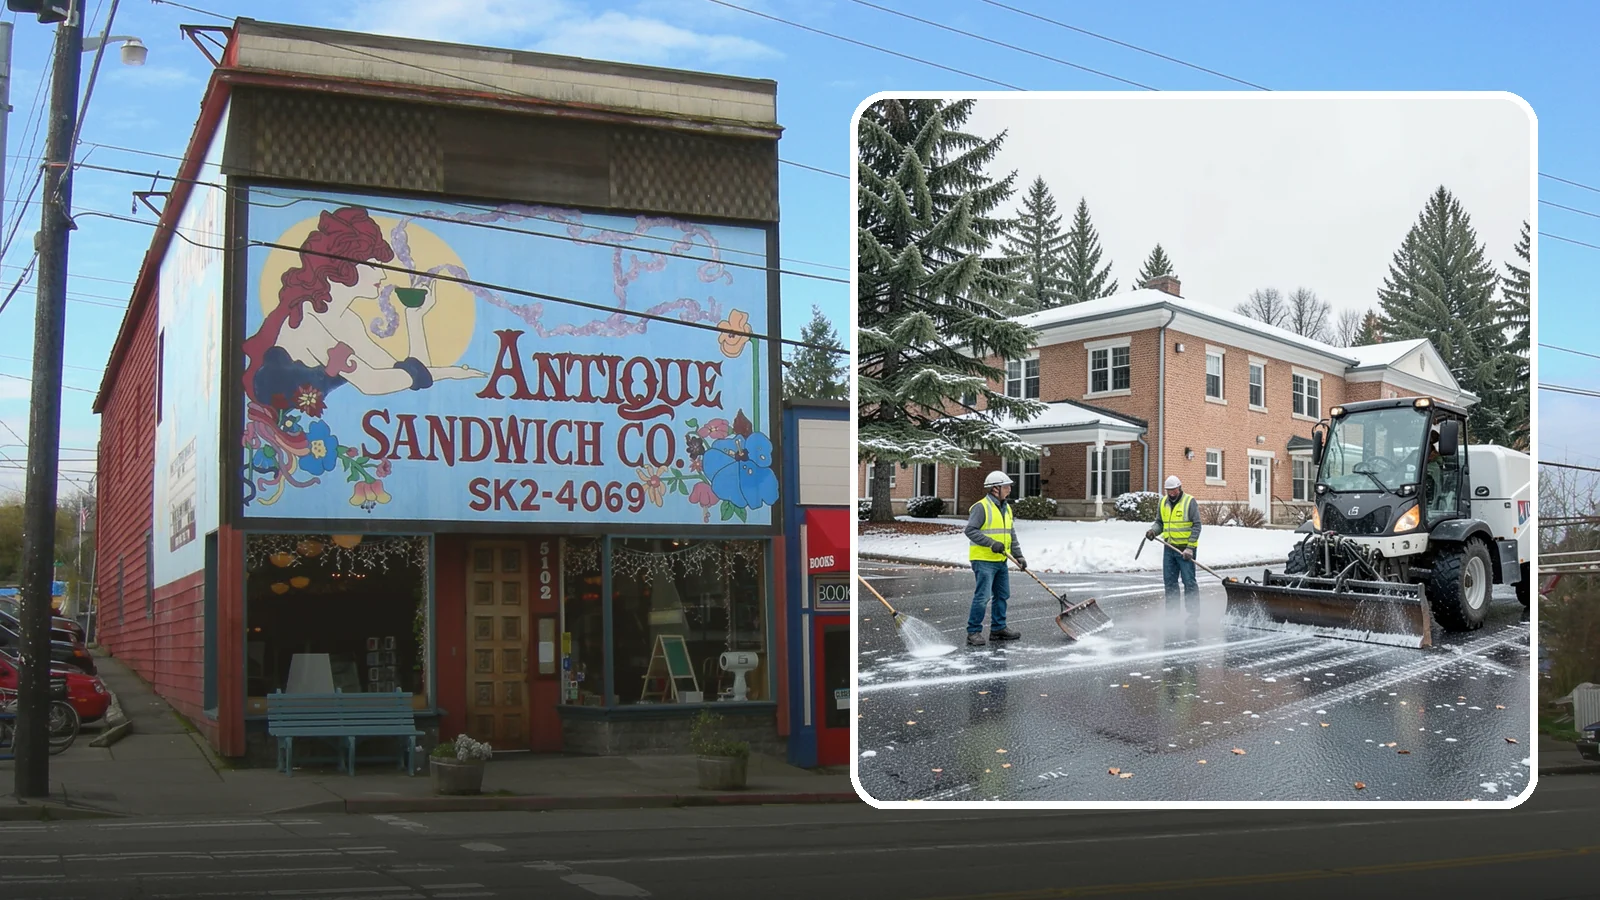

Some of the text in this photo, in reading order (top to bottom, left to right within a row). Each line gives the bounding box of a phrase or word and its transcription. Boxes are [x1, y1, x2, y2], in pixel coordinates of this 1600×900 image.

[475, 329, 723, 421] ANTIQUE
[361, 409, 685, 469] SANDWICH CO.
[468, 476, 645, 513] SK2-4069
[538, 541, 552, 600] 5102
[809, 555, 835, 568] BOOKS
